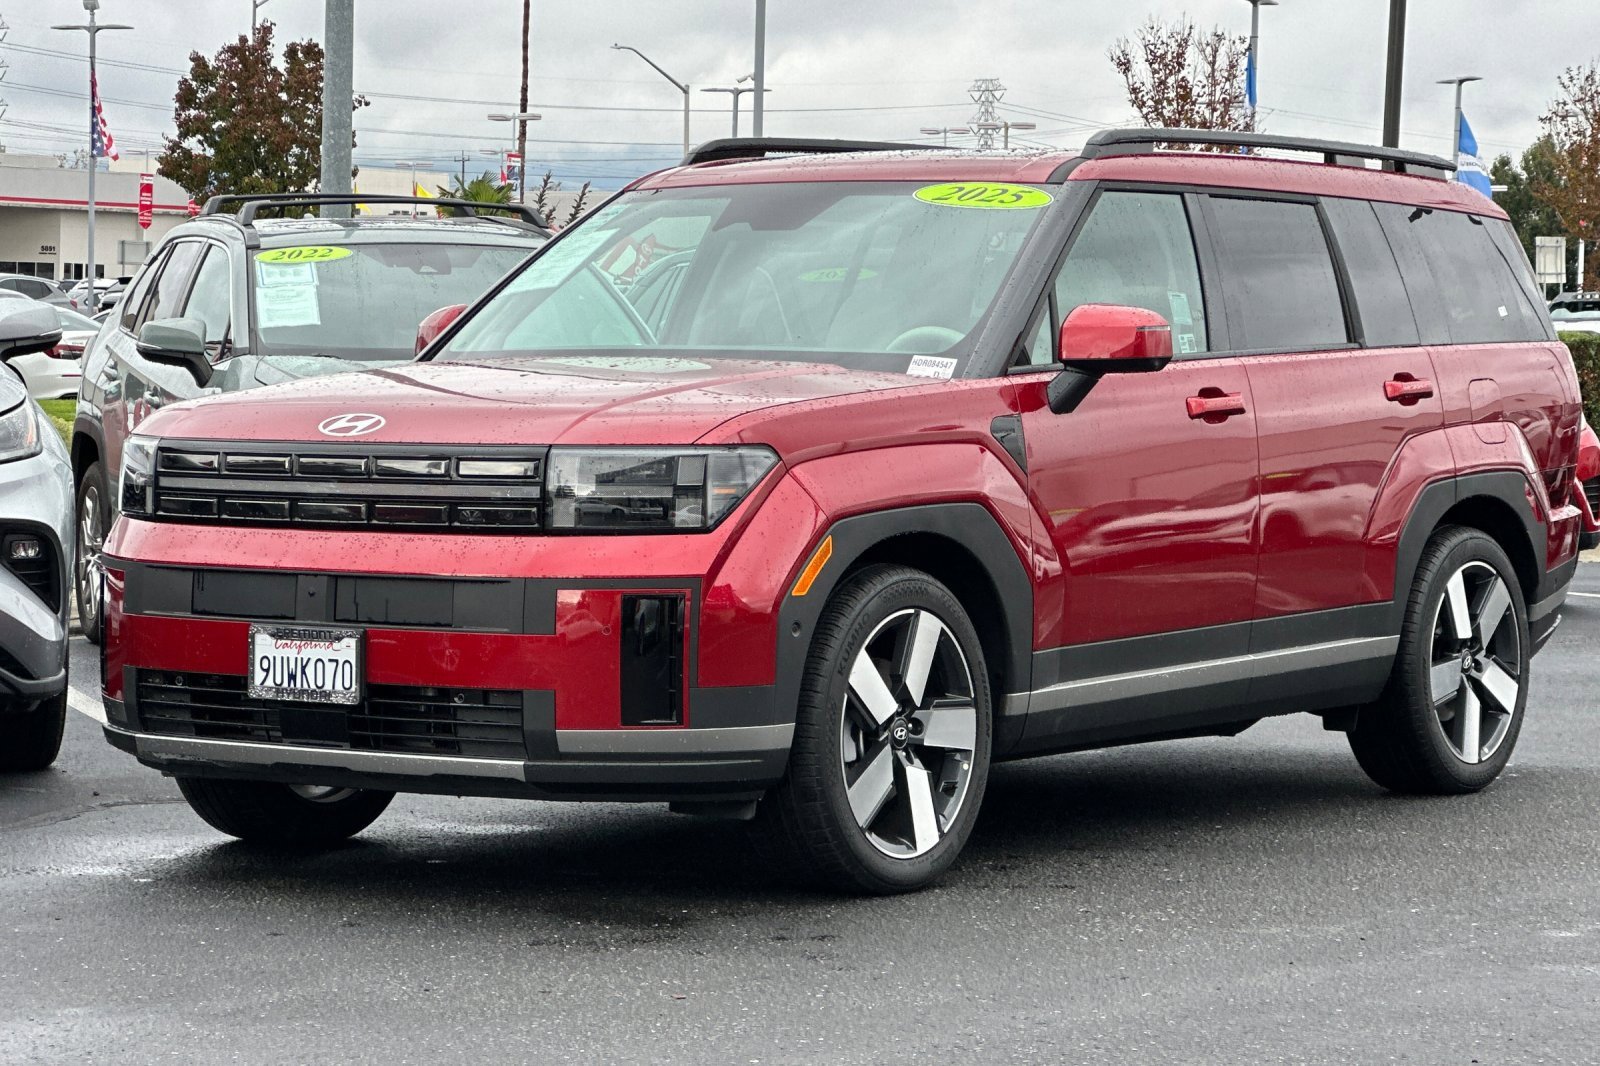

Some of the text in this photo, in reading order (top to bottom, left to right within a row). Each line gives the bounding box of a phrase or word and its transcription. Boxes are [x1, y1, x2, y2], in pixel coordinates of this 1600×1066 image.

[931, 185, 1035, 205] 2025
[270, 247, 334, 261] 2022
[274, 640, 342, 655] California
[836, 612, 871, 678] KUMHO
[259, 655, 353, 691] 9UWK070
